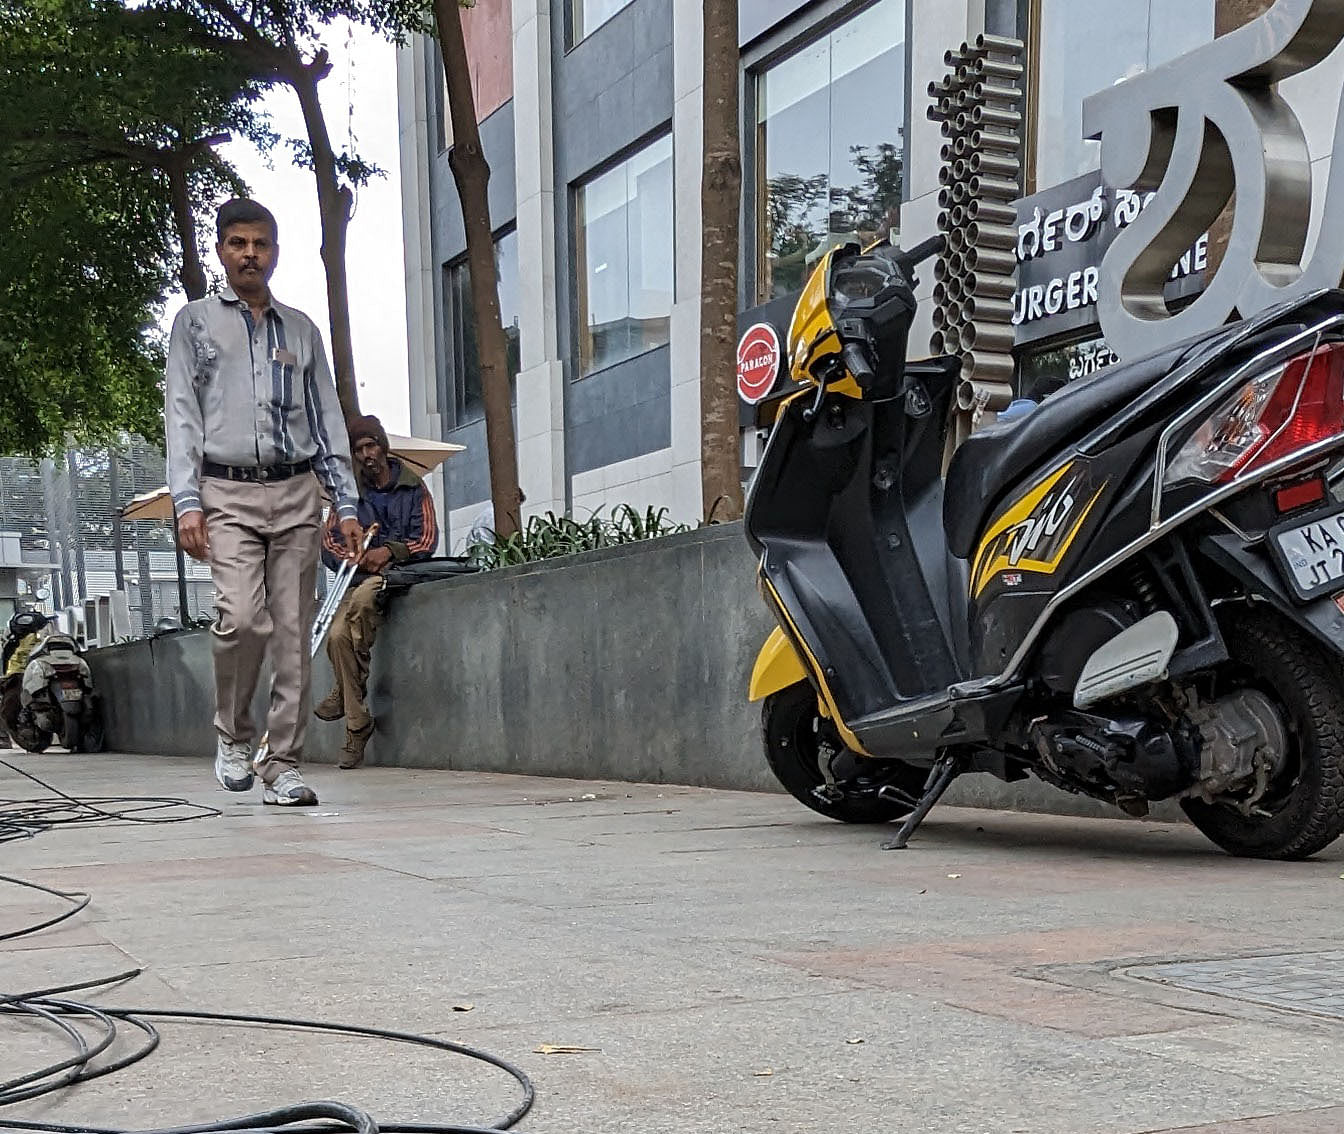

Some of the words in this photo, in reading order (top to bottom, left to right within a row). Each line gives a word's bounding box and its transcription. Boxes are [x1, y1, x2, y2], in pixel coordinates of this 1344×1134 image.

[1010, 266, 1099, 326] URGER
[1301, 524, 1337, 554] KA
[1309, 560, 1332, 585] JT
